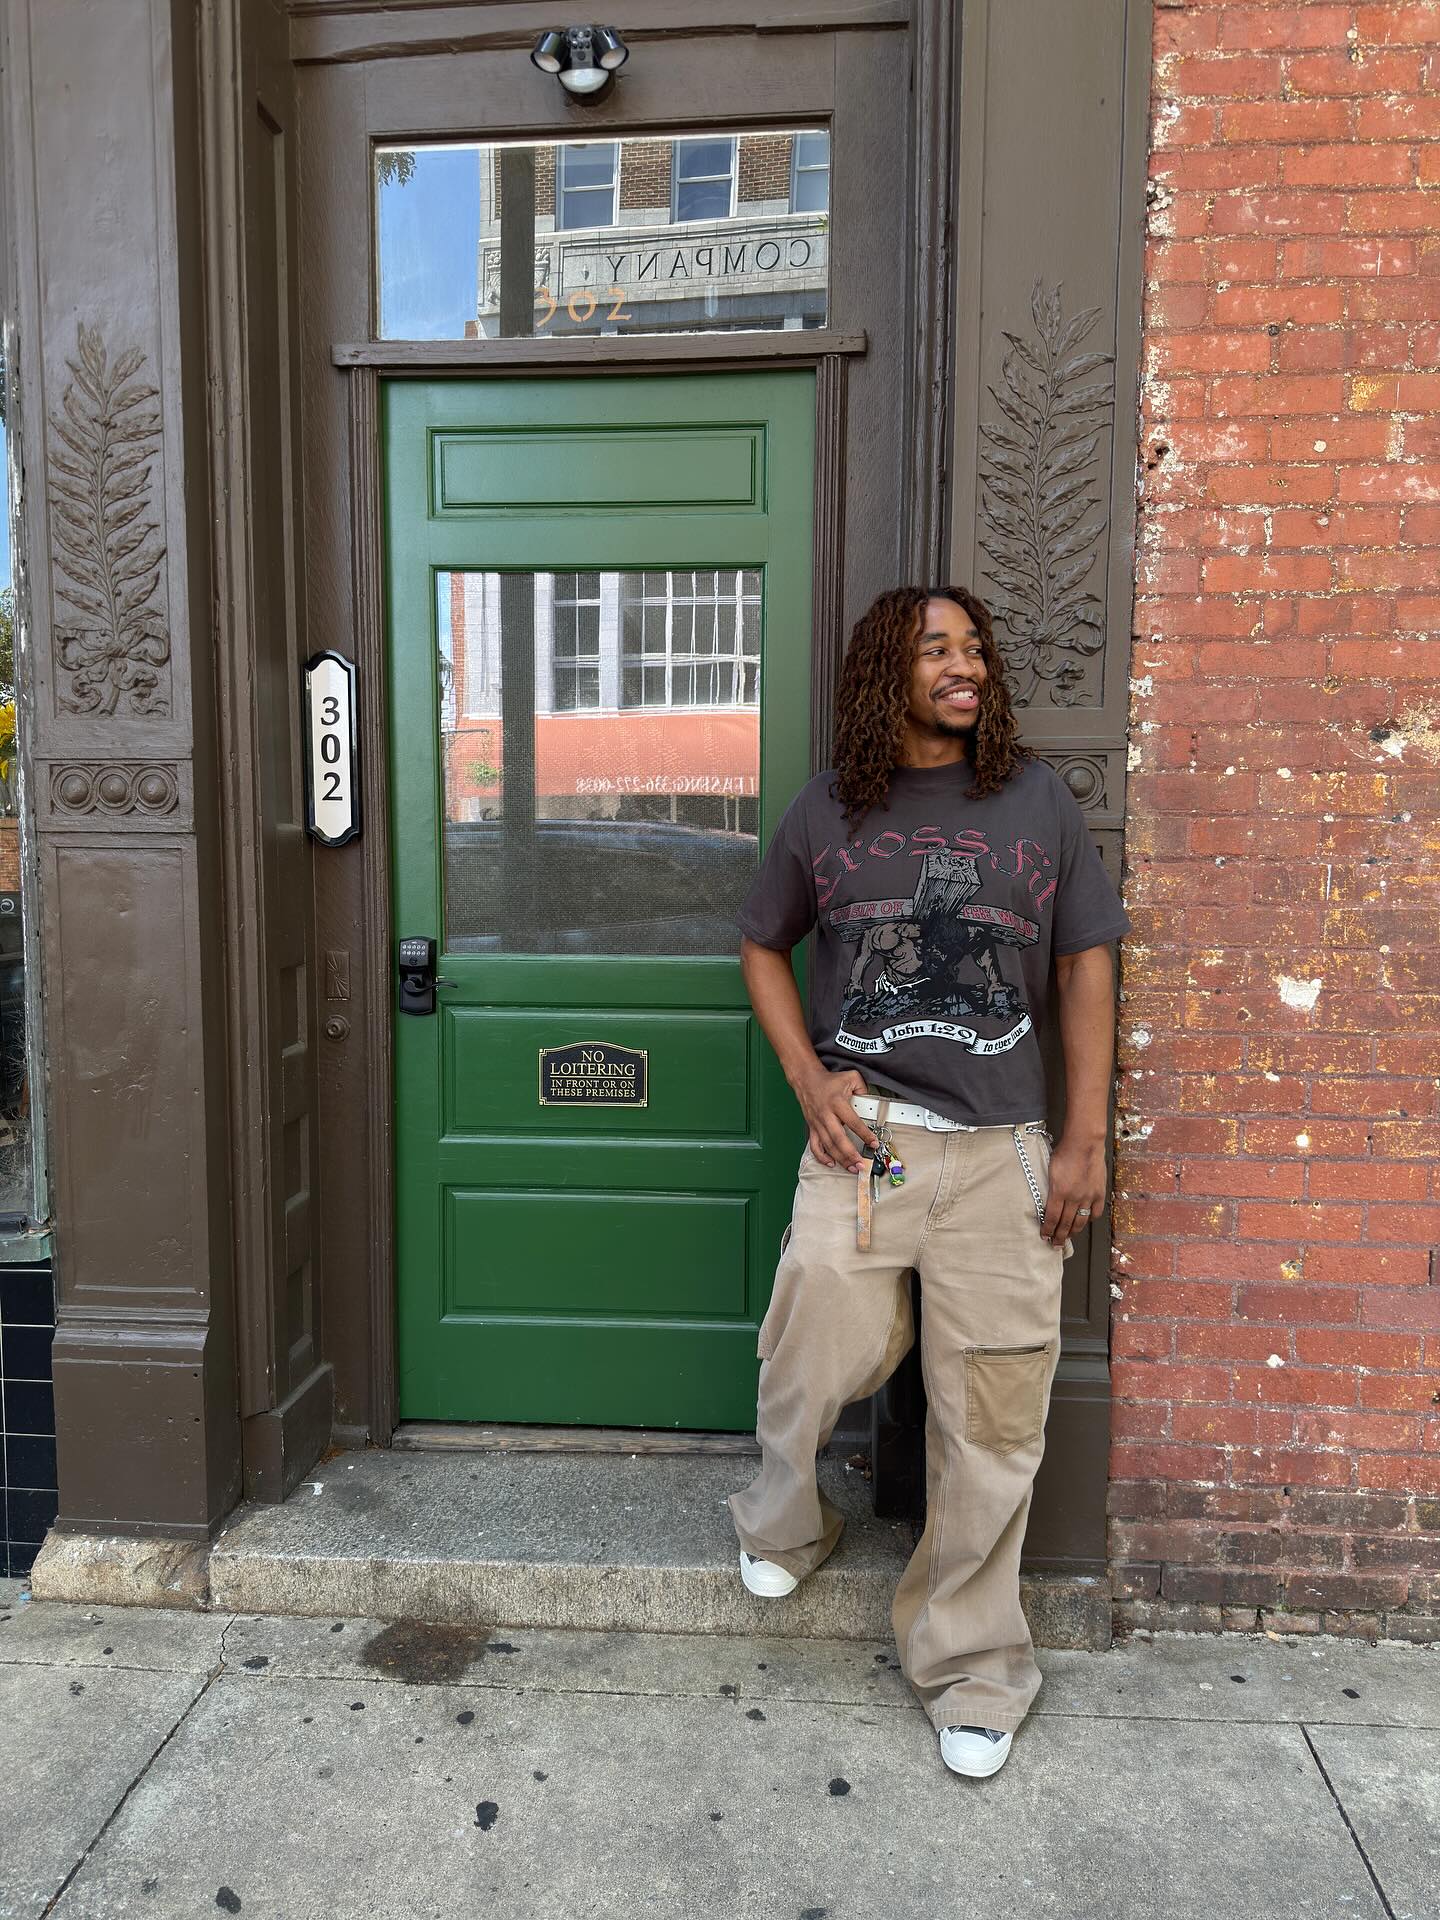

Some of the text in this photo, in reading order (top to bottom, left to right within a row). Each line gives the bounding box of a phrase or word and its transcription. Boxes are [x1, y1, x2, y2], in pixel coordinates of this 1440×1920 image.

[534, 286, 632, 328] 302
[320, 696, 343, 801] 302
[881, 901, 904, 915] OF
[995, 910, 1034, 937] WLD
[838, 1034, 878, 1052] strongest
[888, 1024, 925, 1041] John
[927, 1023, 974, 1041] 1:29
[984, 1042, 993, 1053] to
[581, 1050, 605, 1063] NO
[550, 1062, 636, 1076] LOITERING
[551, 1079, 635, 1089] IN FRONT OR ON
[550, 1088, 636, 1098] THESE PREMISES
